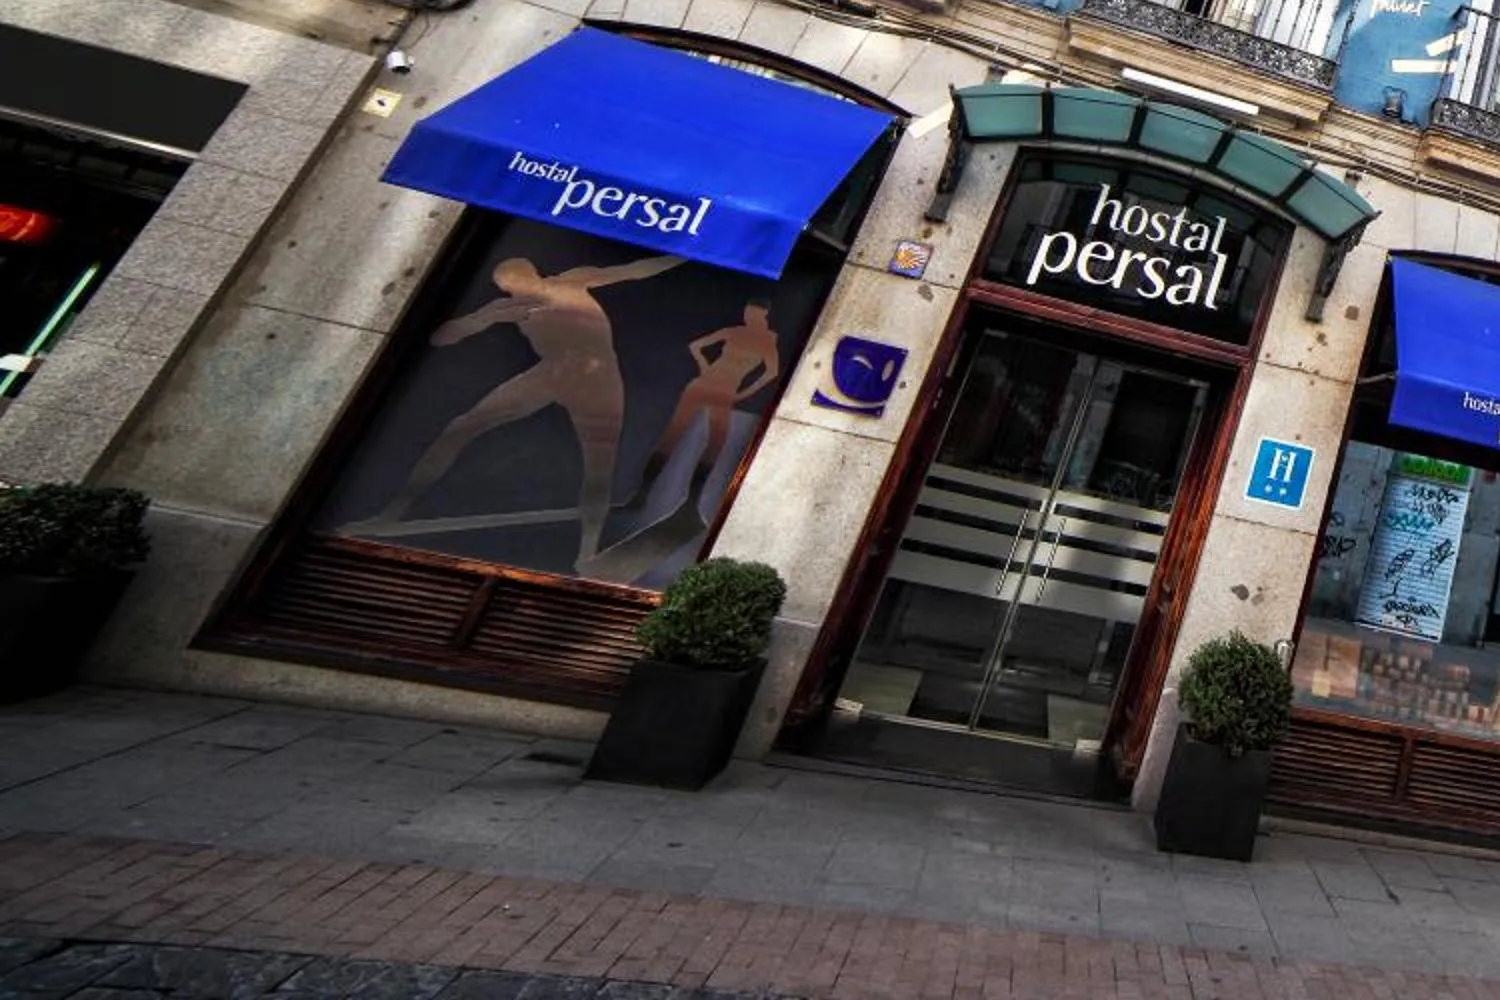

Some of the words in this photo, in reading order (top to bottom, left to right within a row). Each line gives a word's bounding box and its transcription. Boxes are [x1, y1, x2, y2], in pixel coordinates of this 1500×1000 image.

[508, 151, 578, 183] hostal
[551, 179, 712, 236] persal
[1090, 183, 1227, 254] hostal
[1026, 231, 1228, 311] persal
